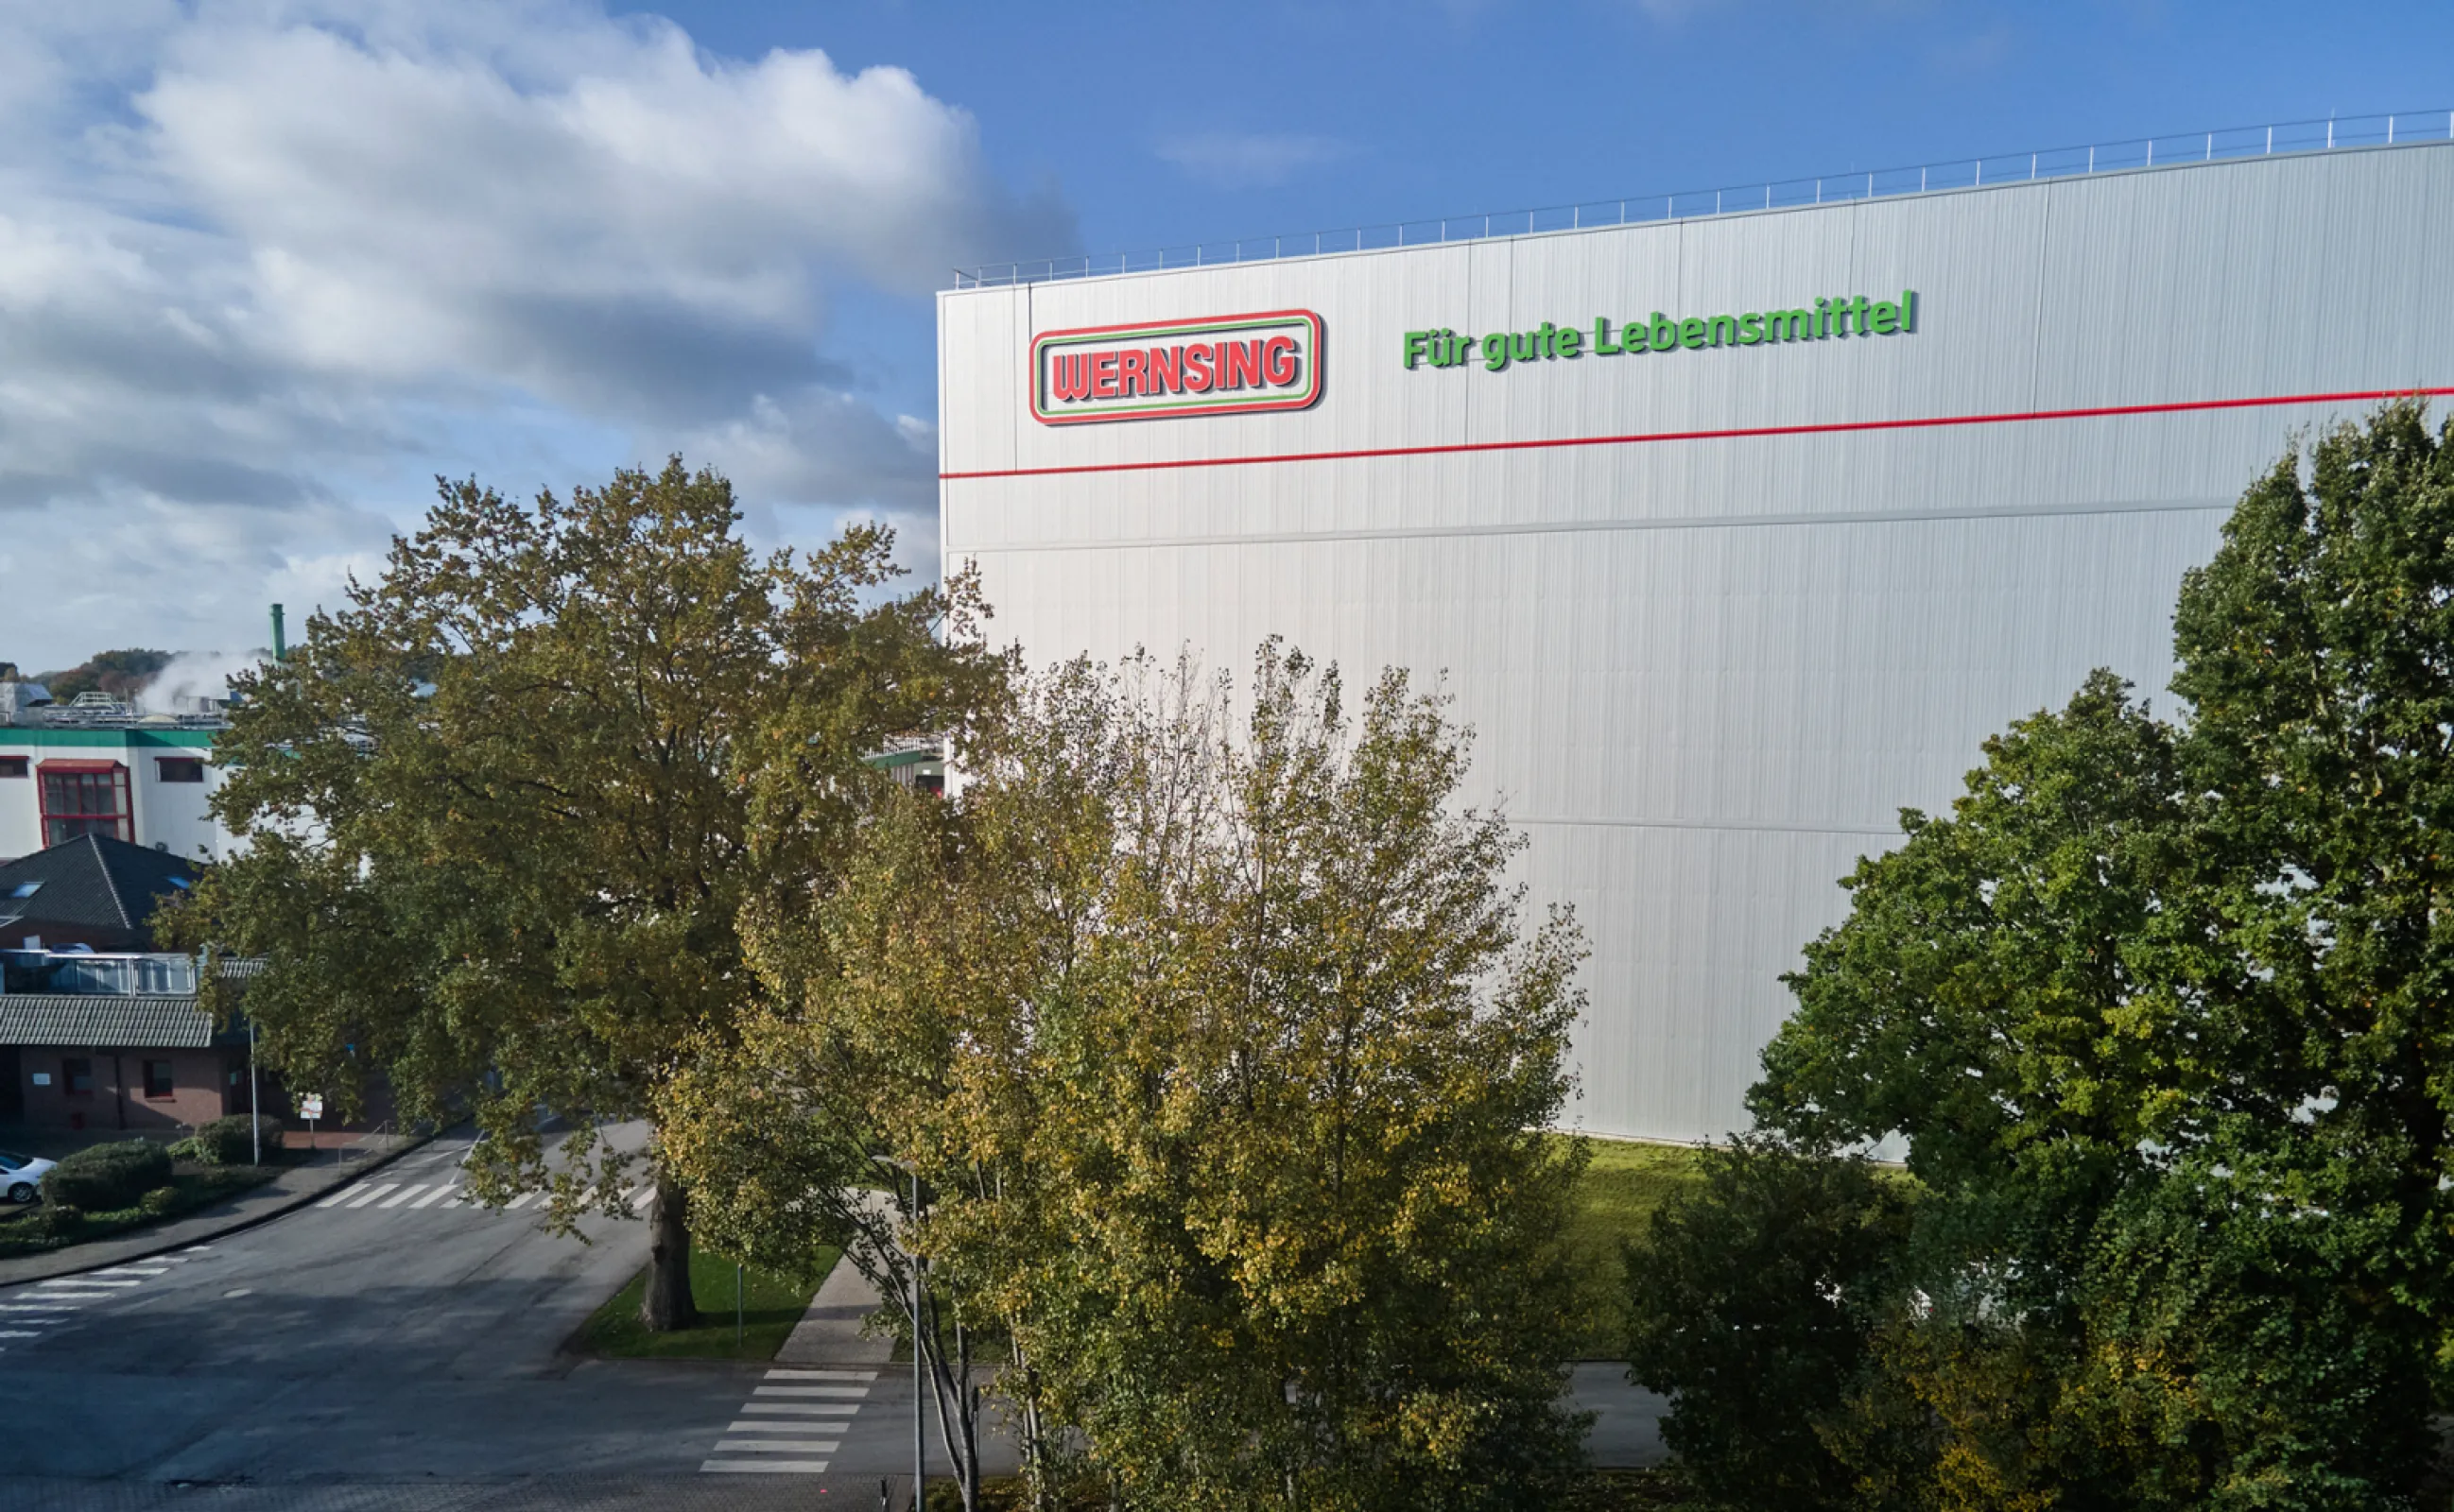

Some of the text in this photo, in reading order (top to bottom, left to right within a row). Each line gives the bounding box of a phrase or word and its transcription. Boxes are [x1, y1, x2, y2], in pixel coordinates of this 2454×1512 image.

[1404, 289, 1913, 370] Für gute Lebensmittel
[1053, 335, 1295, 401] WERNSING
